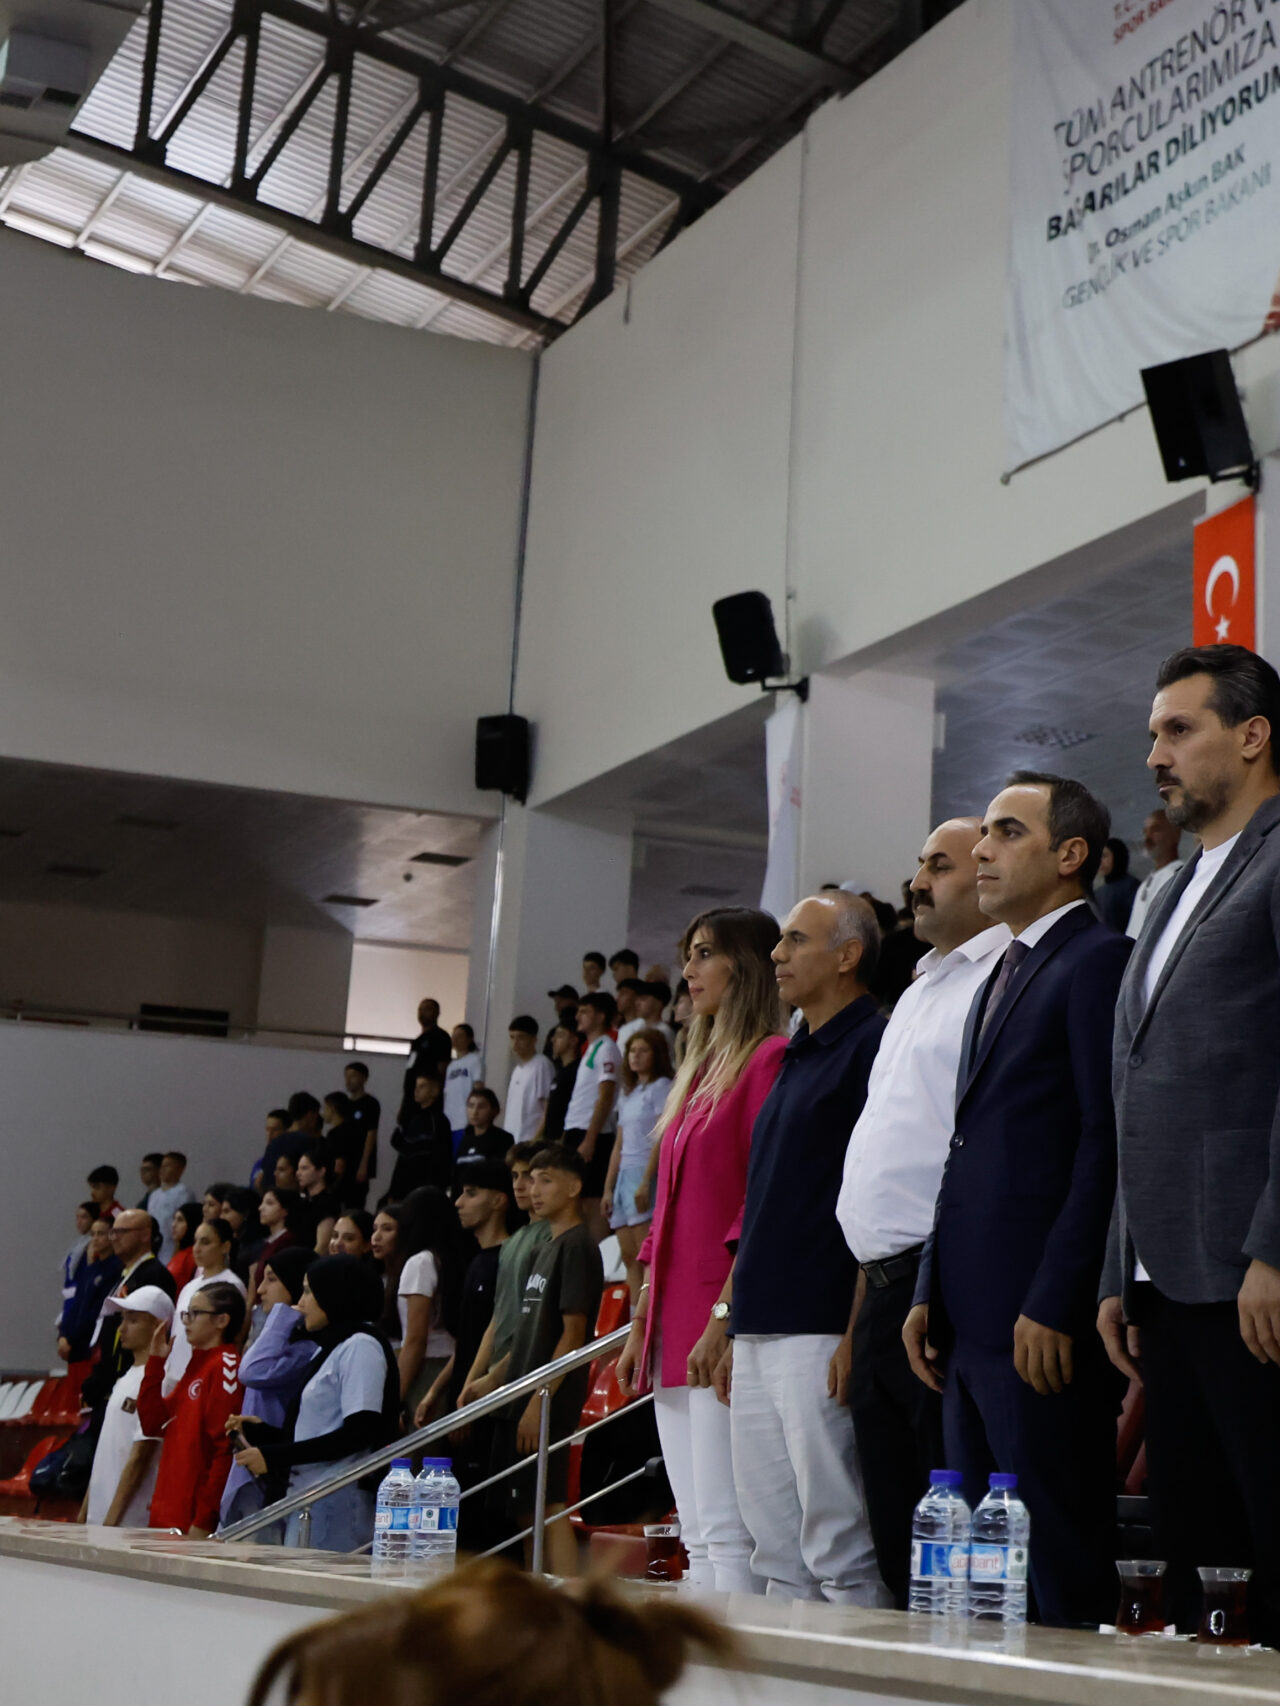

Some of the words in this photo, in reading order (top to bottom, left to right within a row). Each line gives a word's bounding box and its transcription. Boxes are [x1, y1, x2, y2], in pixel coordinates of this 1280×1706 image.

[1110, 0, 1246, 120] ANTRENÖR
[1104, 204, 1161, 248] Osman
[1211, 142, 1245, 183] BAK
[1132, 238, 1153, 268] VE
[1157, 209, 1200, 257] SPOR
